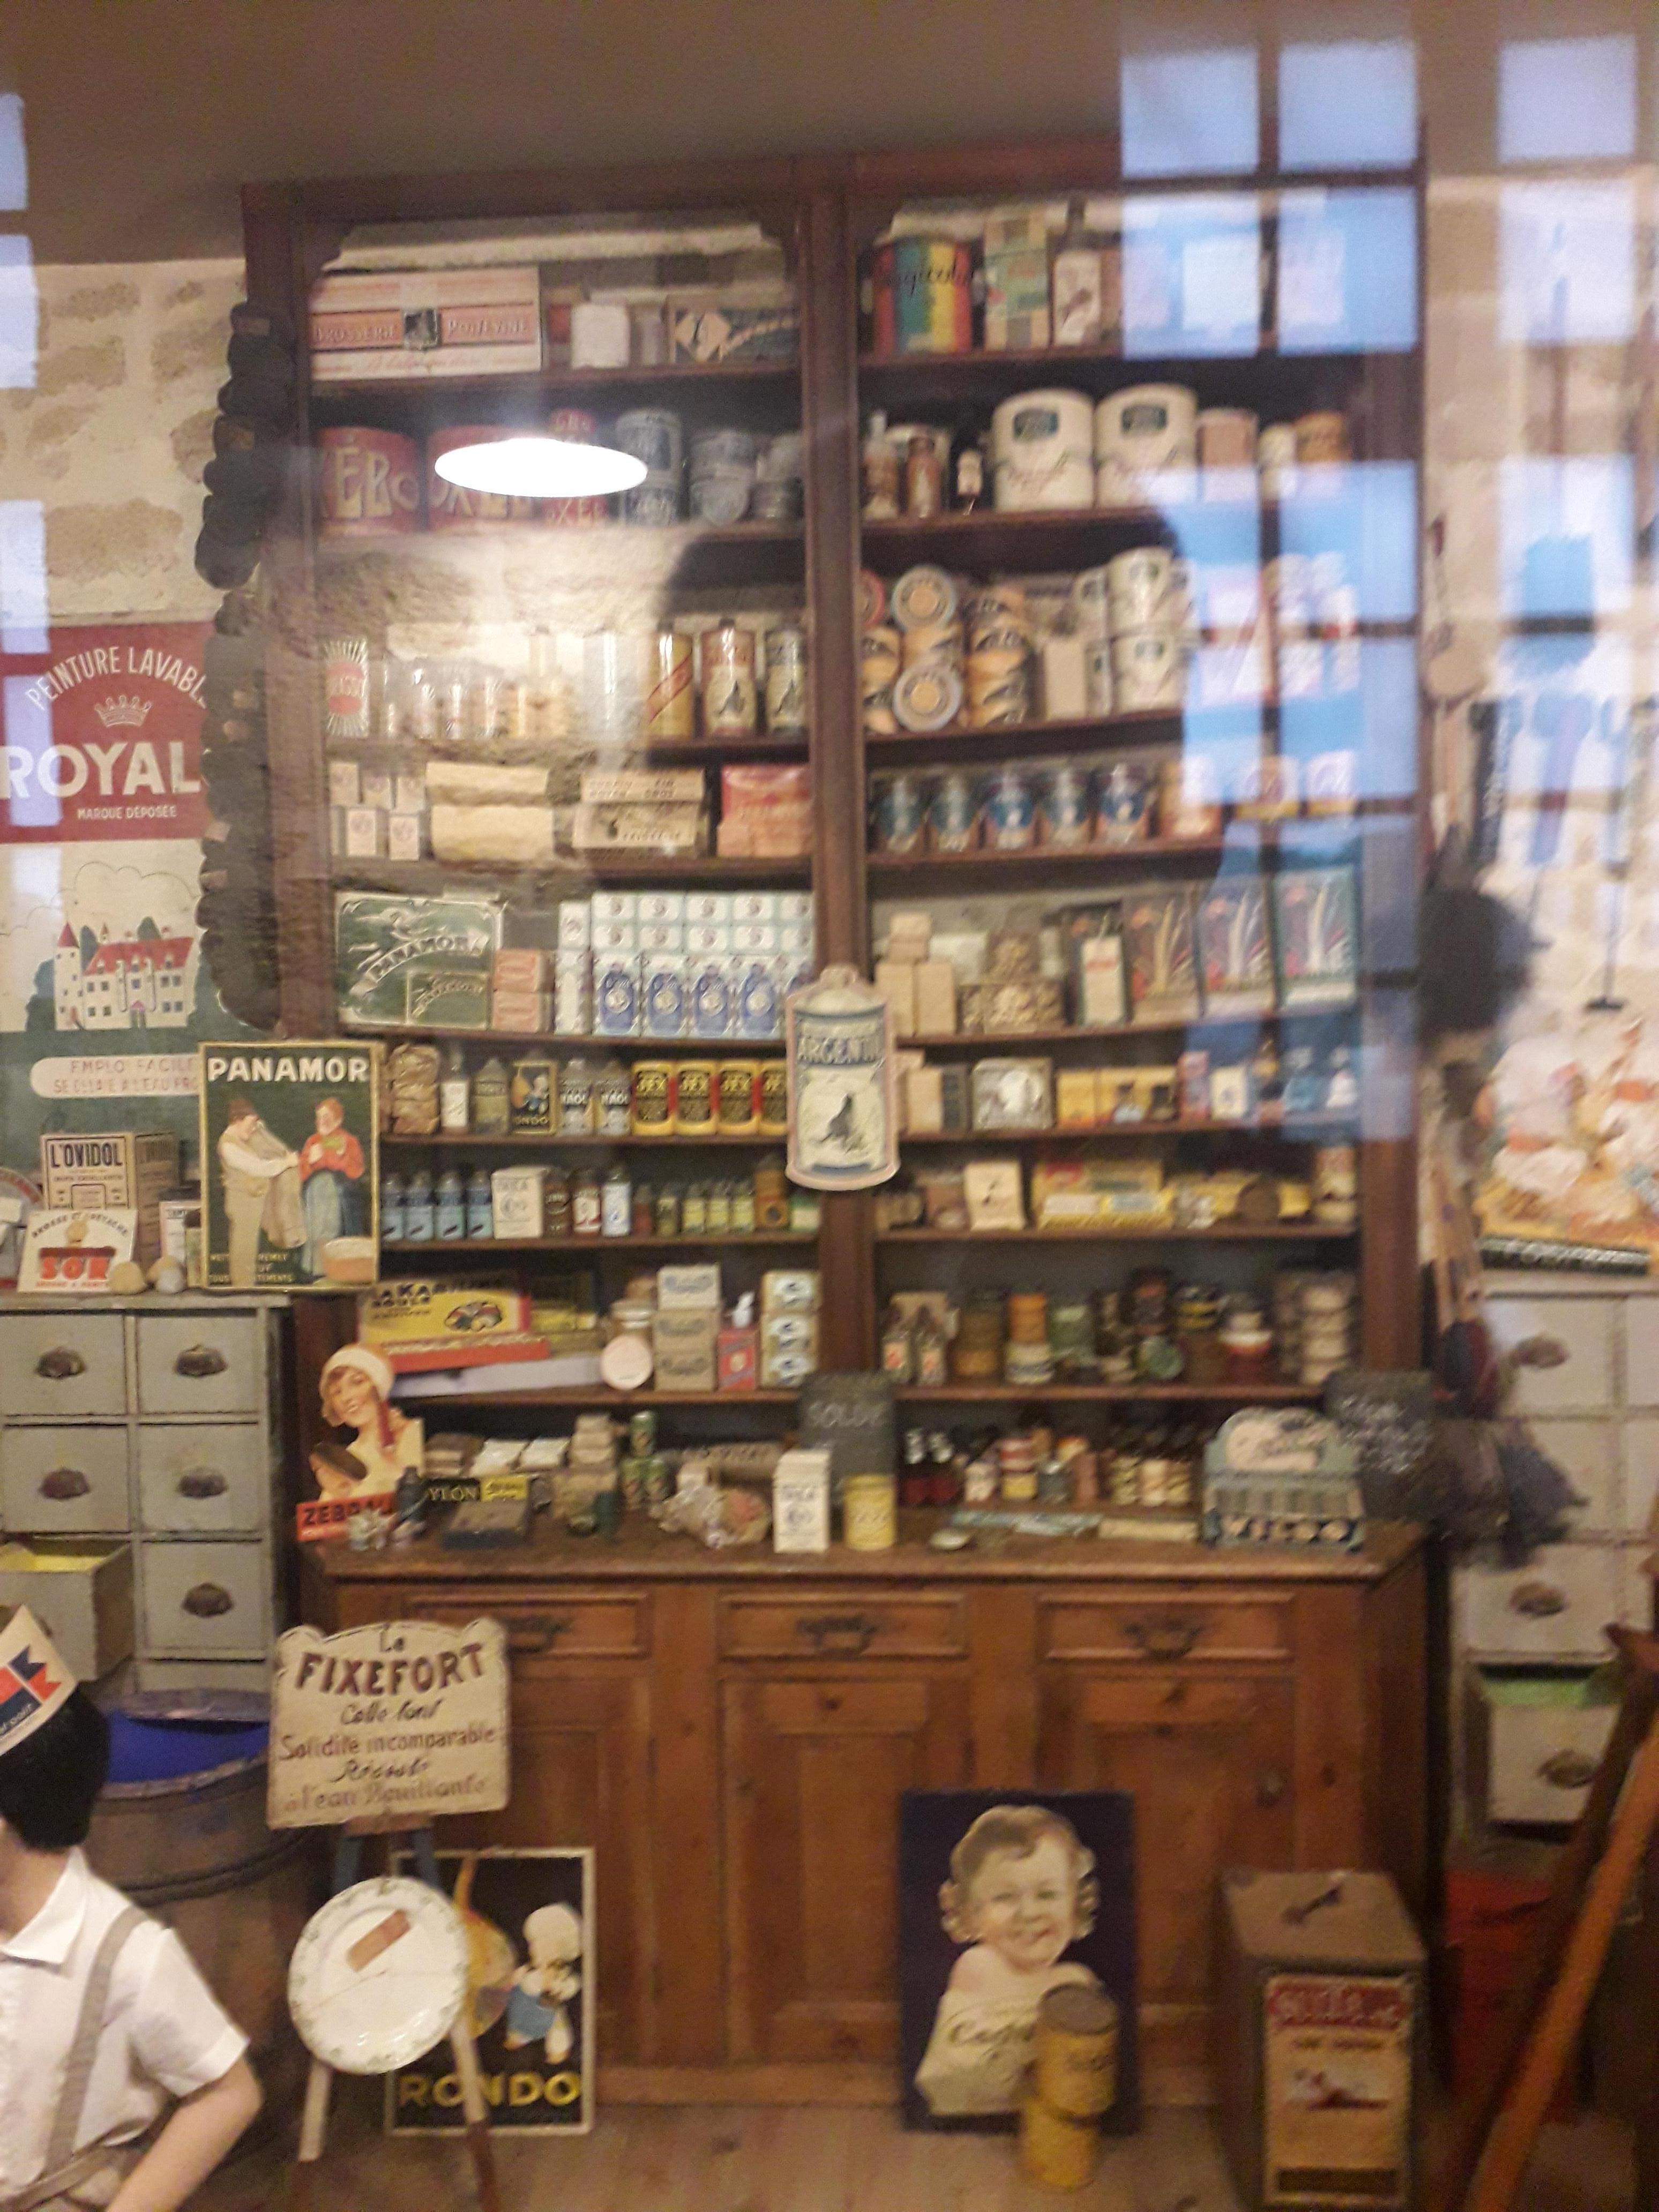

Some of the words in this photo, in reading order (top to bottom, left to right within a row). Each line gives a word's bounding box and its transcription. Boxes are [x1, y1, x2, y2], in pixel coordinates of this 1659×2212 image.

[26, 646, 121, 711] PEINTURE
[128, 646, 207, 710] LAVABL
[0, 742, 201, 798] ROYAL
[77, 805, 123, 820] MARQUE
[207, 1056, 370, 1082] PANAMOR
[50, 1142, 123, 1168] L'OVIDOL
[379, 1629, 404, 1652] Le
[296, 1643, 484, 1696] FIXEFORT
[399, 2072, 581, 2107] RONDO
